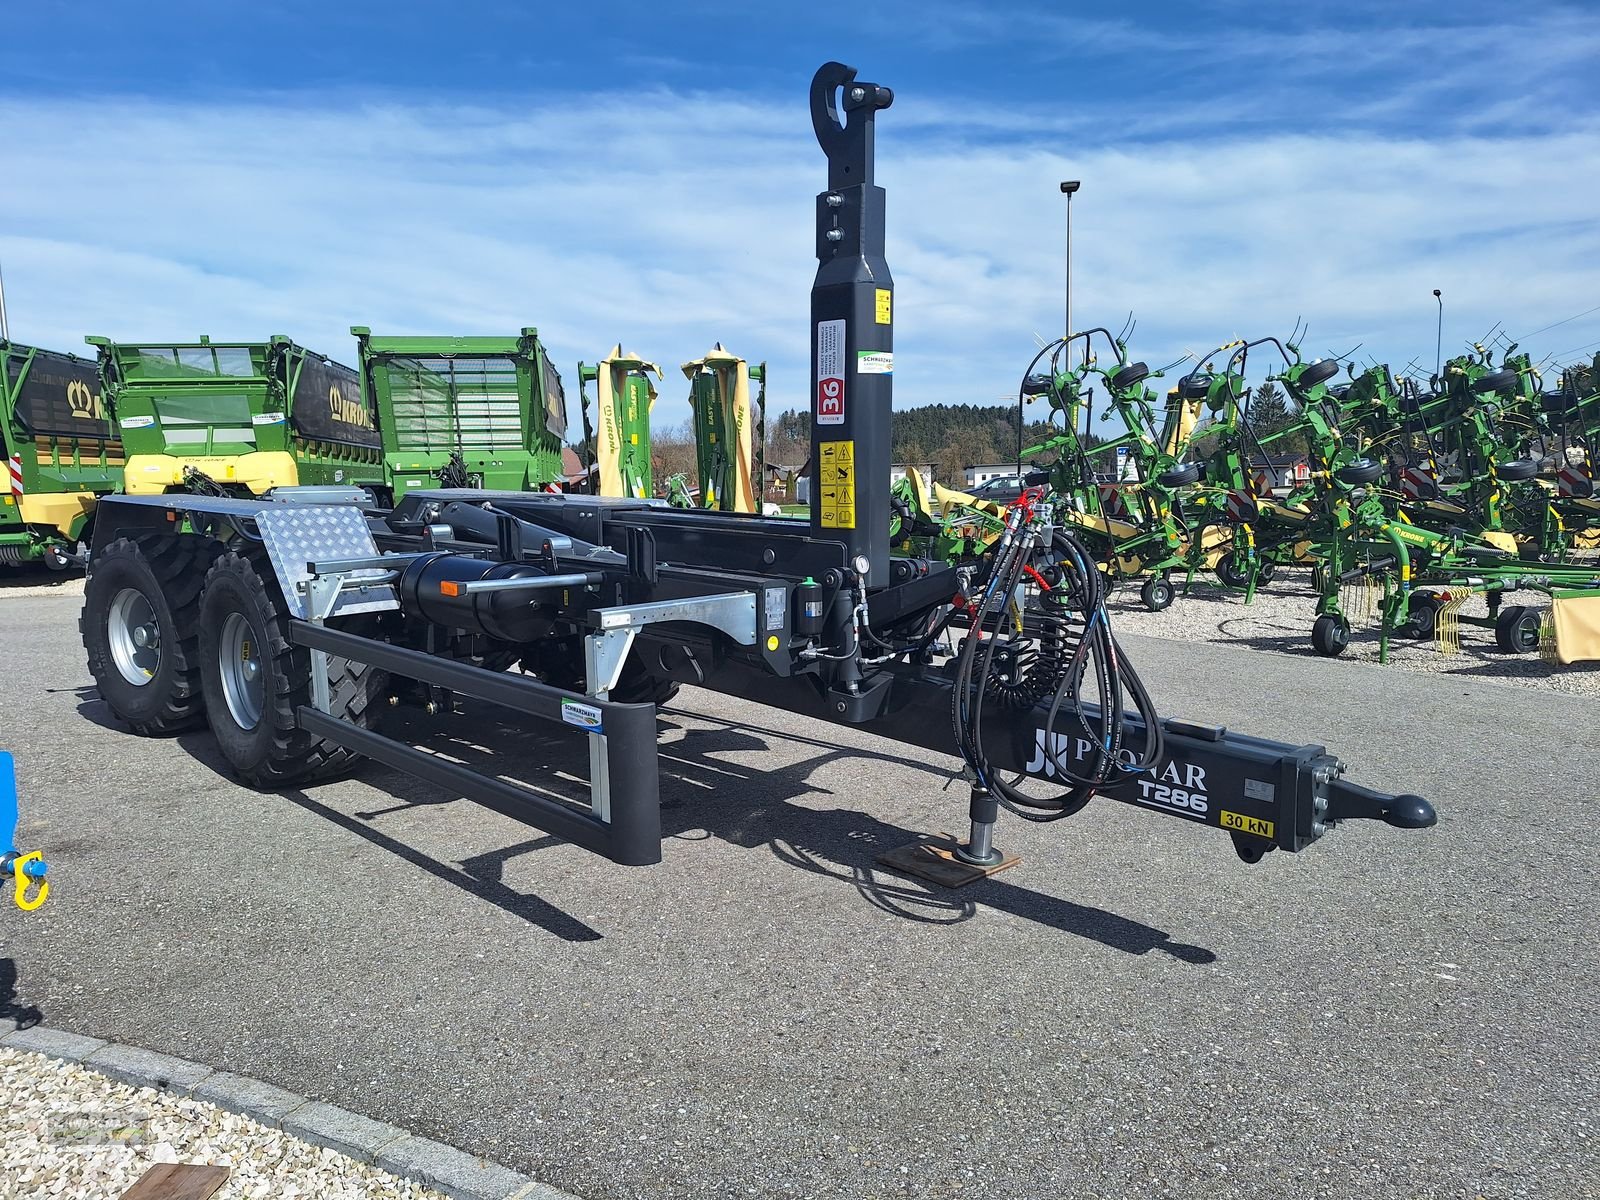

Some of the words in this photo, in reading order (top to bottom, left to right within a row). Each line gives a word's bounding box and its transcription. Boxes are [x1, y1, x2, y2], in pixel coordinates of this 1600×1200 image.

[822, 381, 839, 412] 36
[342, 399, 375, 429] KRON
[736, 405, 745, 437] ONE
[605, 417, 615, 455] KRONE
[1400, 530, 1425, 543] KRONE
[1075, 737, 1208, 791] POAR
[1137, 779, 1208, 813] T286
[1226, 814, 1243, 828] 30
[1248, 819, 1268, 835] kN
